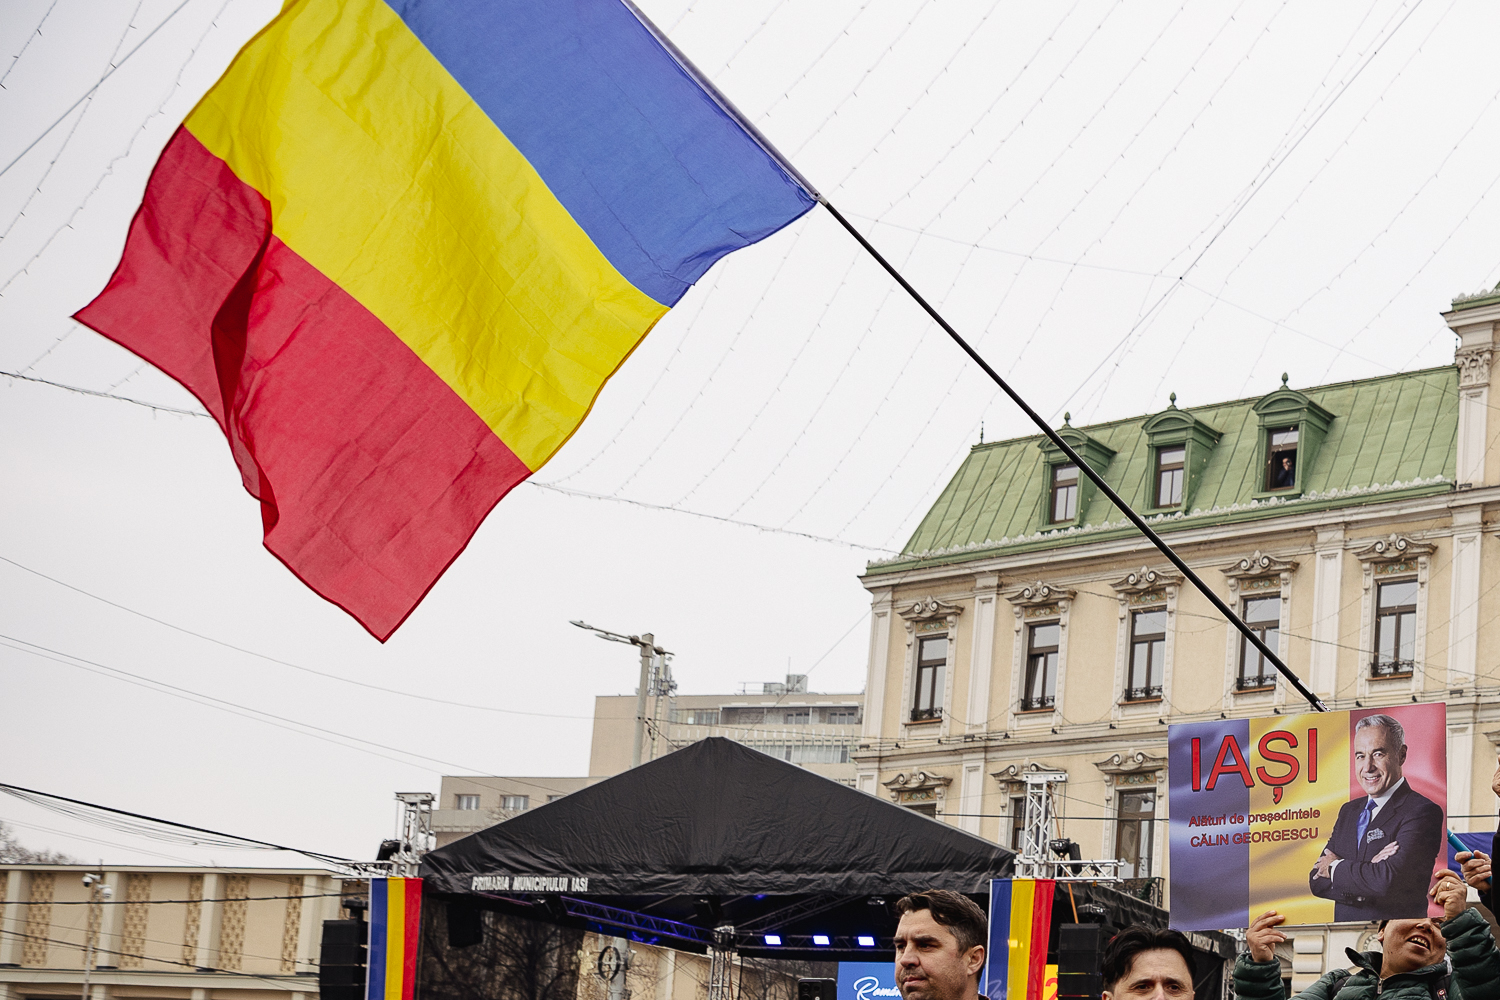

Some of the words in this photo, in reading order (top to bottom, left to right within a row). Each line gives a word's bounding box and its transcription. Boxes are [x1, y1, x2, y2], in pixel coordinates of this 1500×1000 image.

[1191, 728, 1318, 804] IAȘI
[1189, 813, 1226, 827] Alături
[1229, 813, 1244, 825] de
[1248, 808, 1321, 825] președintele
[1190, 833, 1229, 847] CĂLIN
[1232, 827, 1319, 844] GEORGESCU
[512, 876, 569, 891] MUNICIPIULUI
